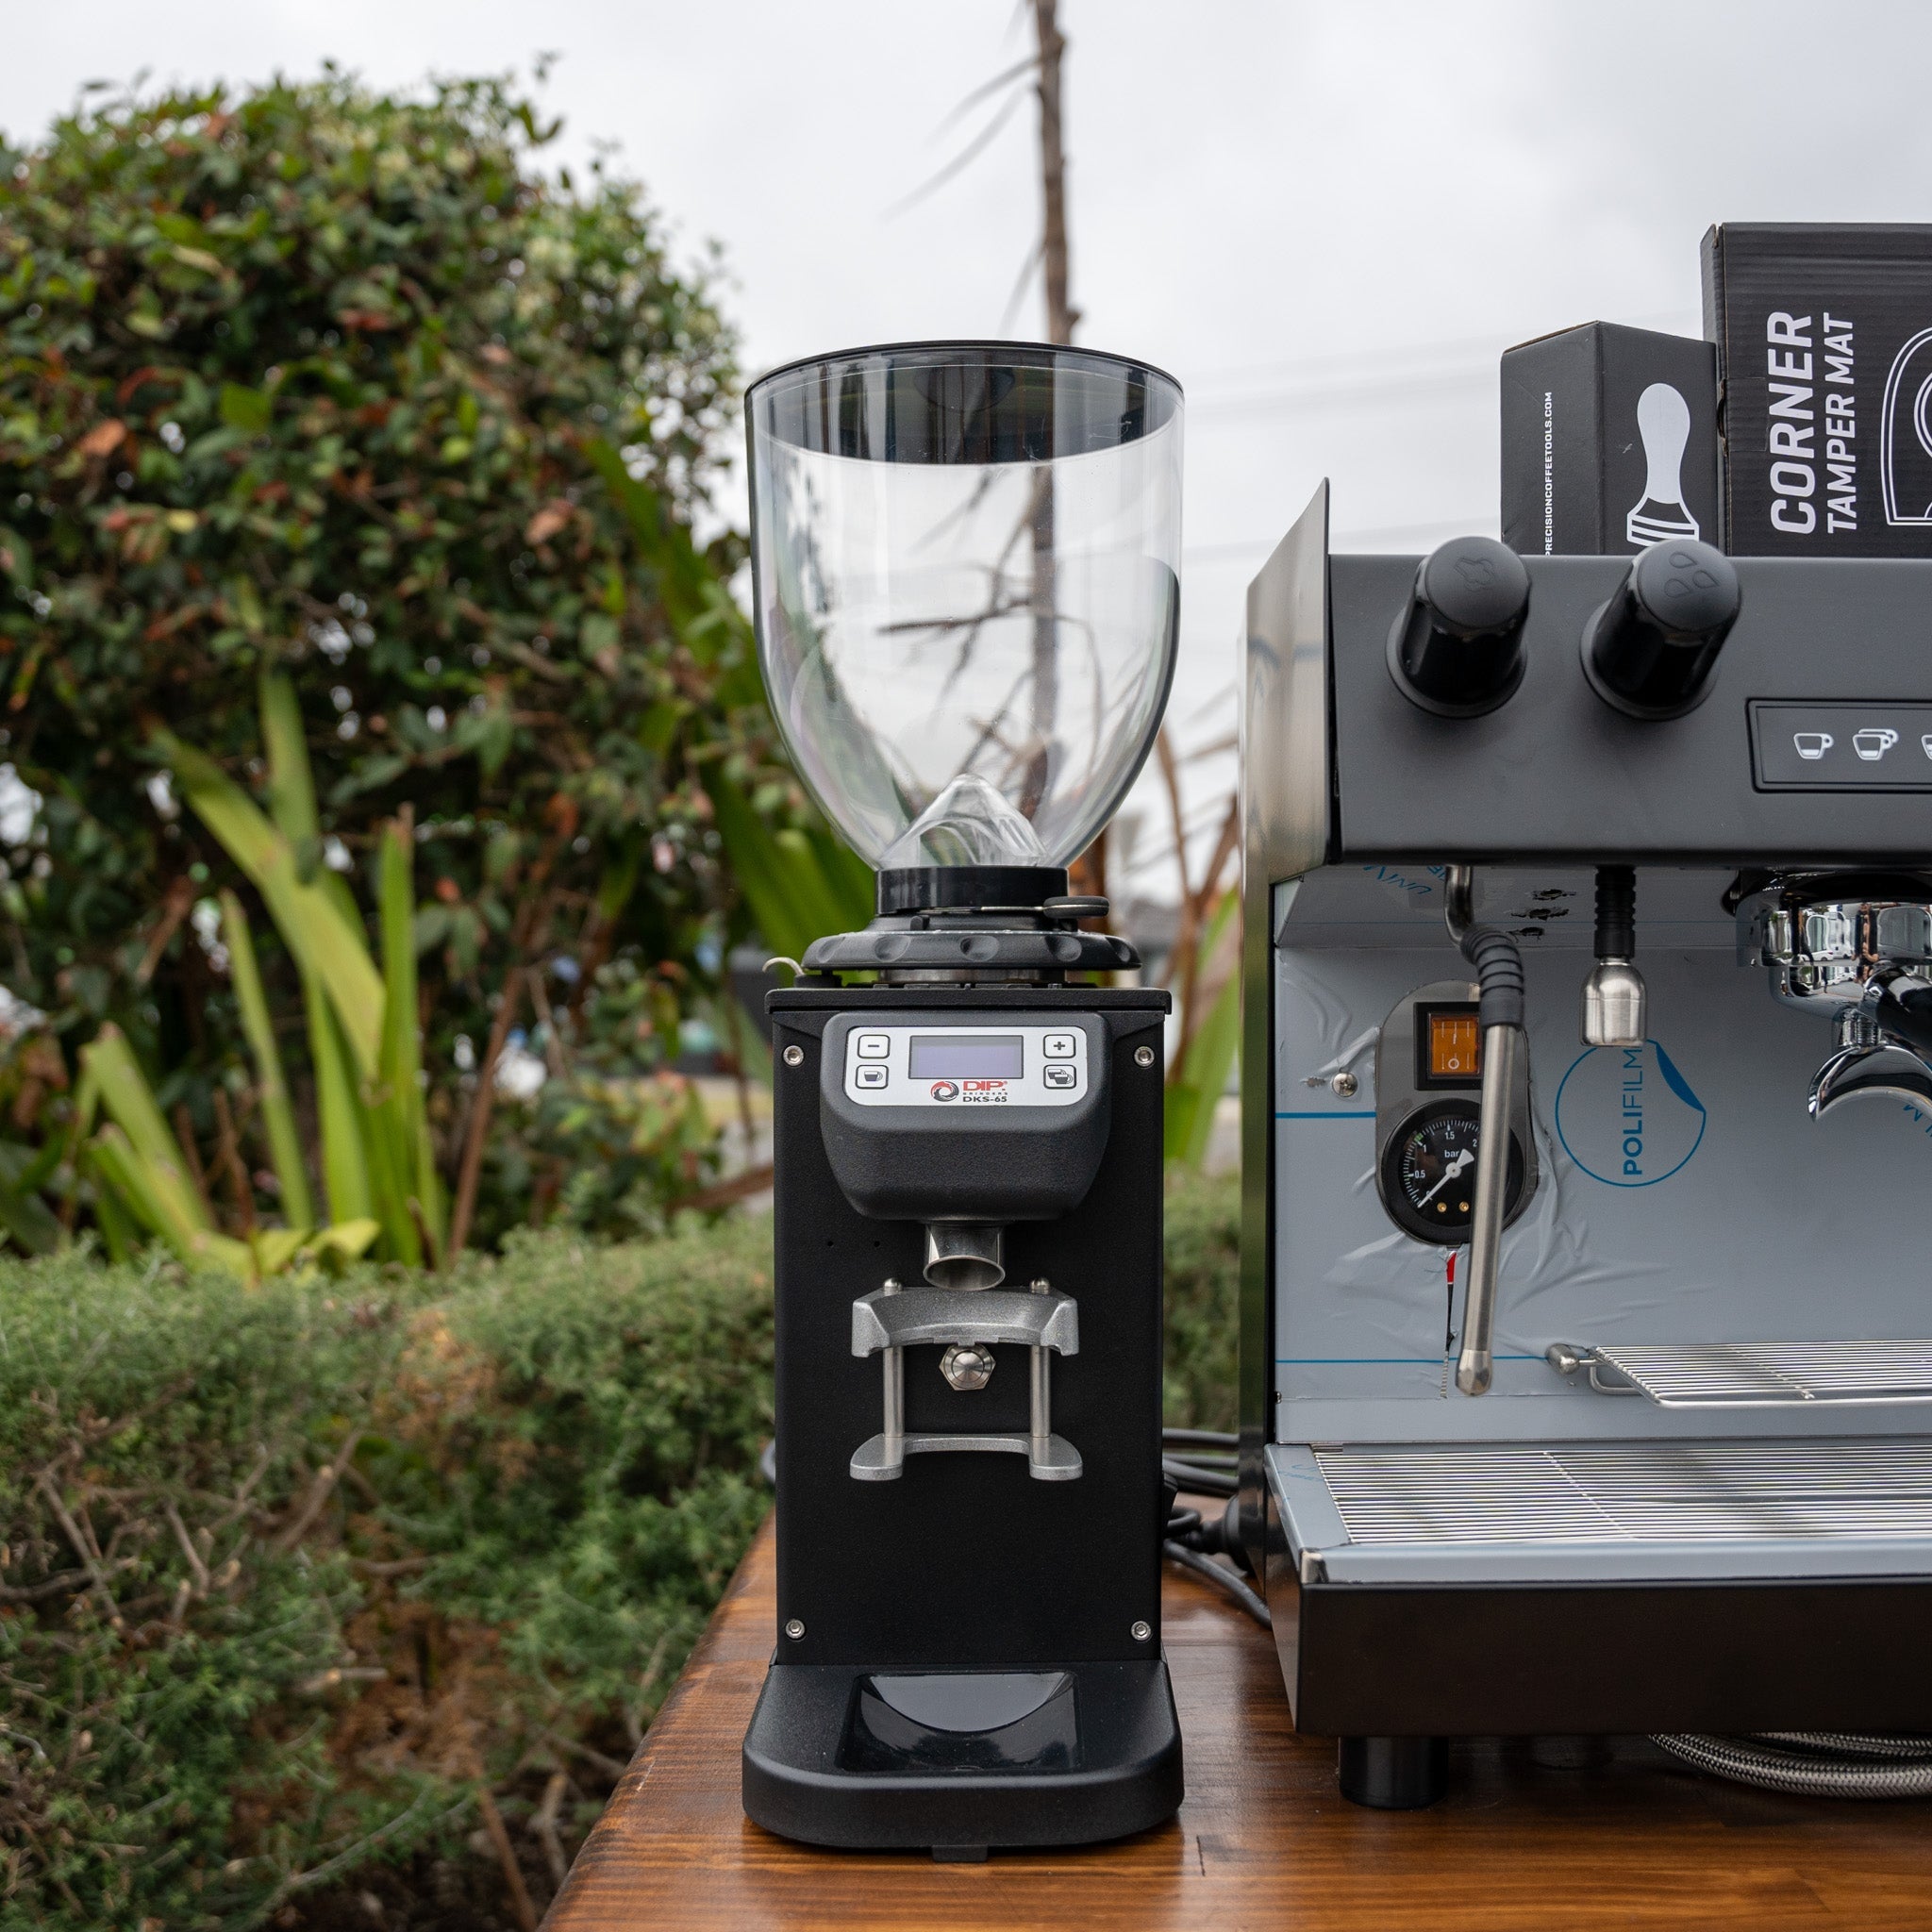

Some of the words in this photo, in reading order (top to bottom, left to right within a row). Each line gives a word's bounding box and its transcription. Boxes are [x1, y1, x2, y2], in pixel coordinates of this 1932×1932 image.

[1824, 311, 1855, 385] MAT
[1767, 311, 1816, 534] CORNER
[1825, 393, 1857, 534] TAMPER
[1622, 1048, 1643, 1175] POLIFILM
[1422, 1144, 1427, 1153] 1
[1444, 1131, 1456, 1141] 1.5
[1444, 1149, 1460, 1158] bar
[1414, 1170, 1426, 1179] 0.5
